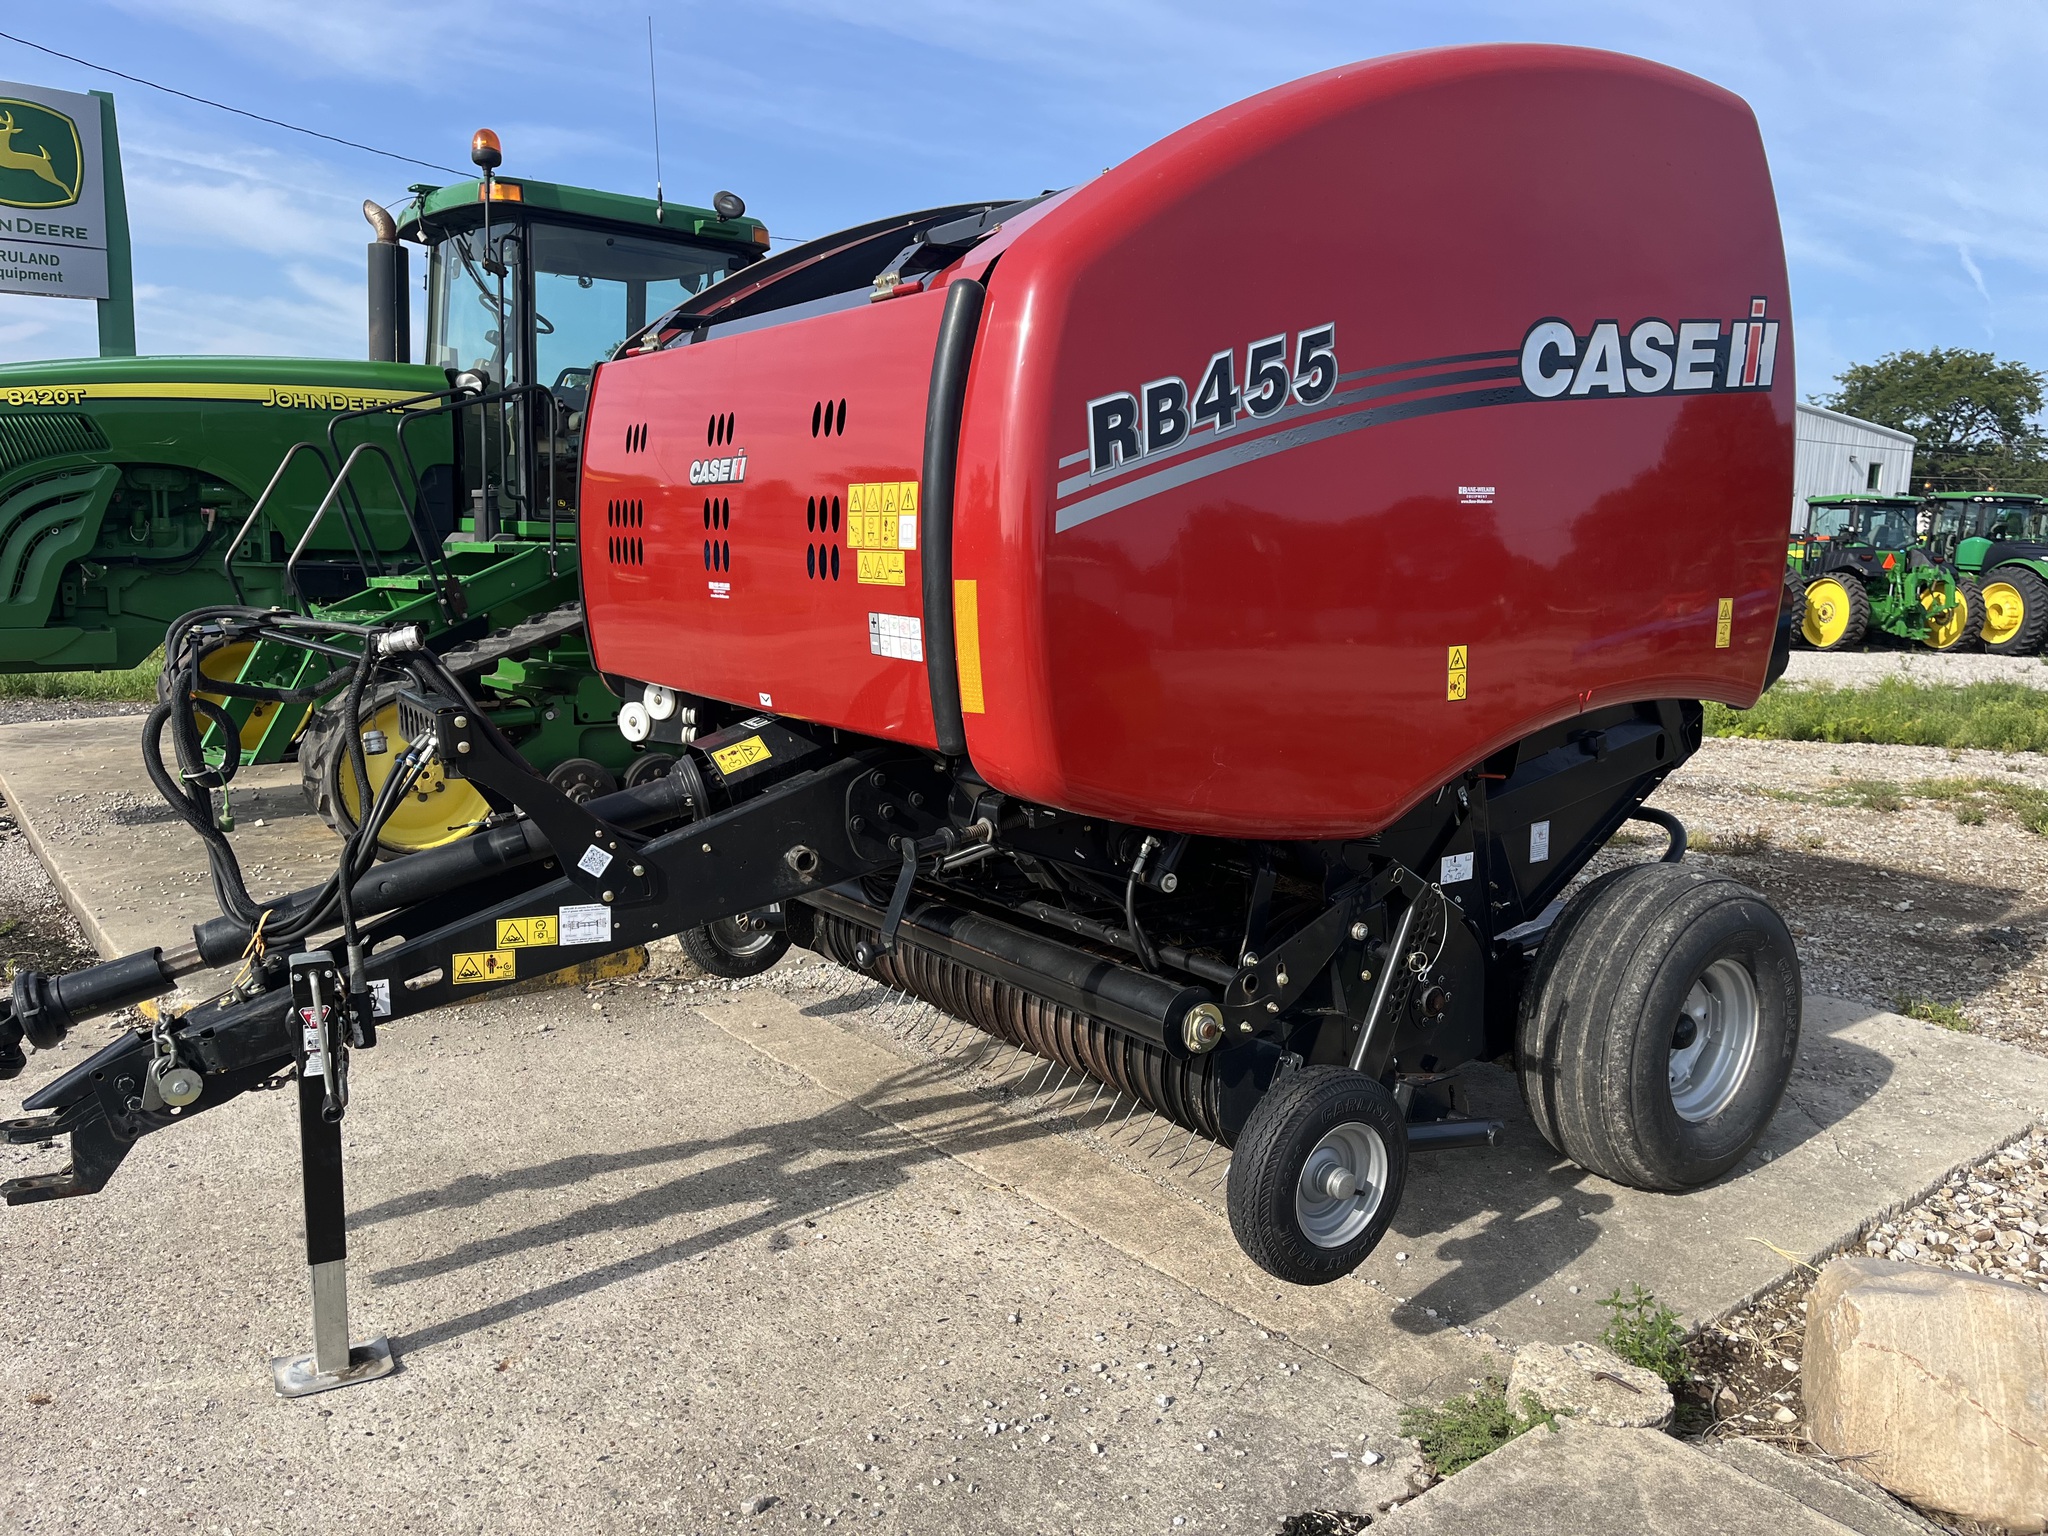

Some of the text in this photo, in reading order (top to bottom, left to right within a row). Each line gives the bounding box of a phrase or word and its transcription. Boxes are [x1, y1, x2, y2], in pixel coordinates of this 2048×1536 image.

[17, 218, 88, 240] DEERE
[1521, 321, 1720, 398] CASE
[7, 389, 86, 406] 8420T
[262, 389, 327, 410] JOHN
[1087, 321, 1338, 477] RB455
[690, 459, 731, 484] CASE
[1778, 957, 1797, 1058] CARLISLE
[1321, 1097, 1396, 1137] CARLISLE
[1278, 1224, 1379, 1272] SPORT TRAIL
